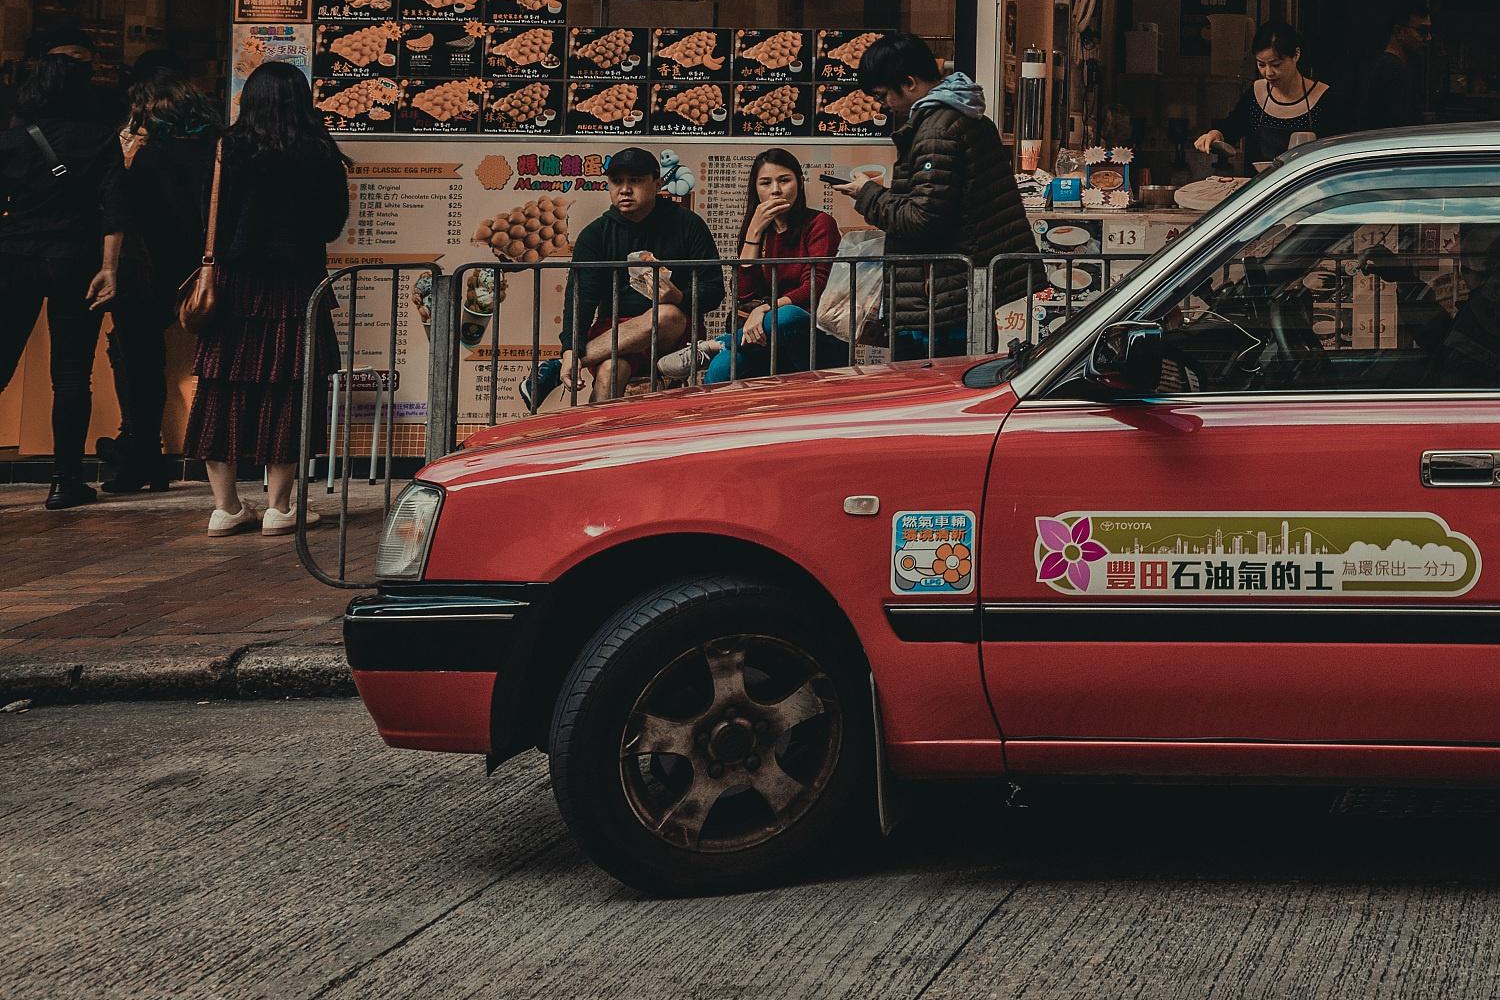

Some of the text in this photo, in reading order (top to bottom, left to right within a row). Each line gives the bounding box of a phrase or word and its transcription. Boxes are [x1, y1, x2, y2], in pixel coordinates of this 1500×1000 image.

[821, 64, 846, 78] 原味
[372, 166, 402, 174] CLASSIC
[377, 184, 401, 192] Original
[514, 177, 609, 193] Mammy Panc
[430, 193, 447, 201] Chips
[902, 515, 967, 529] 燃氣車輛
[1114, 522, 1152, 530] TOYOTA
[1342, 560, 1456, 577] 為環保出一分力
[1106, 561, 1334, 592] 豐田石油氣的士
